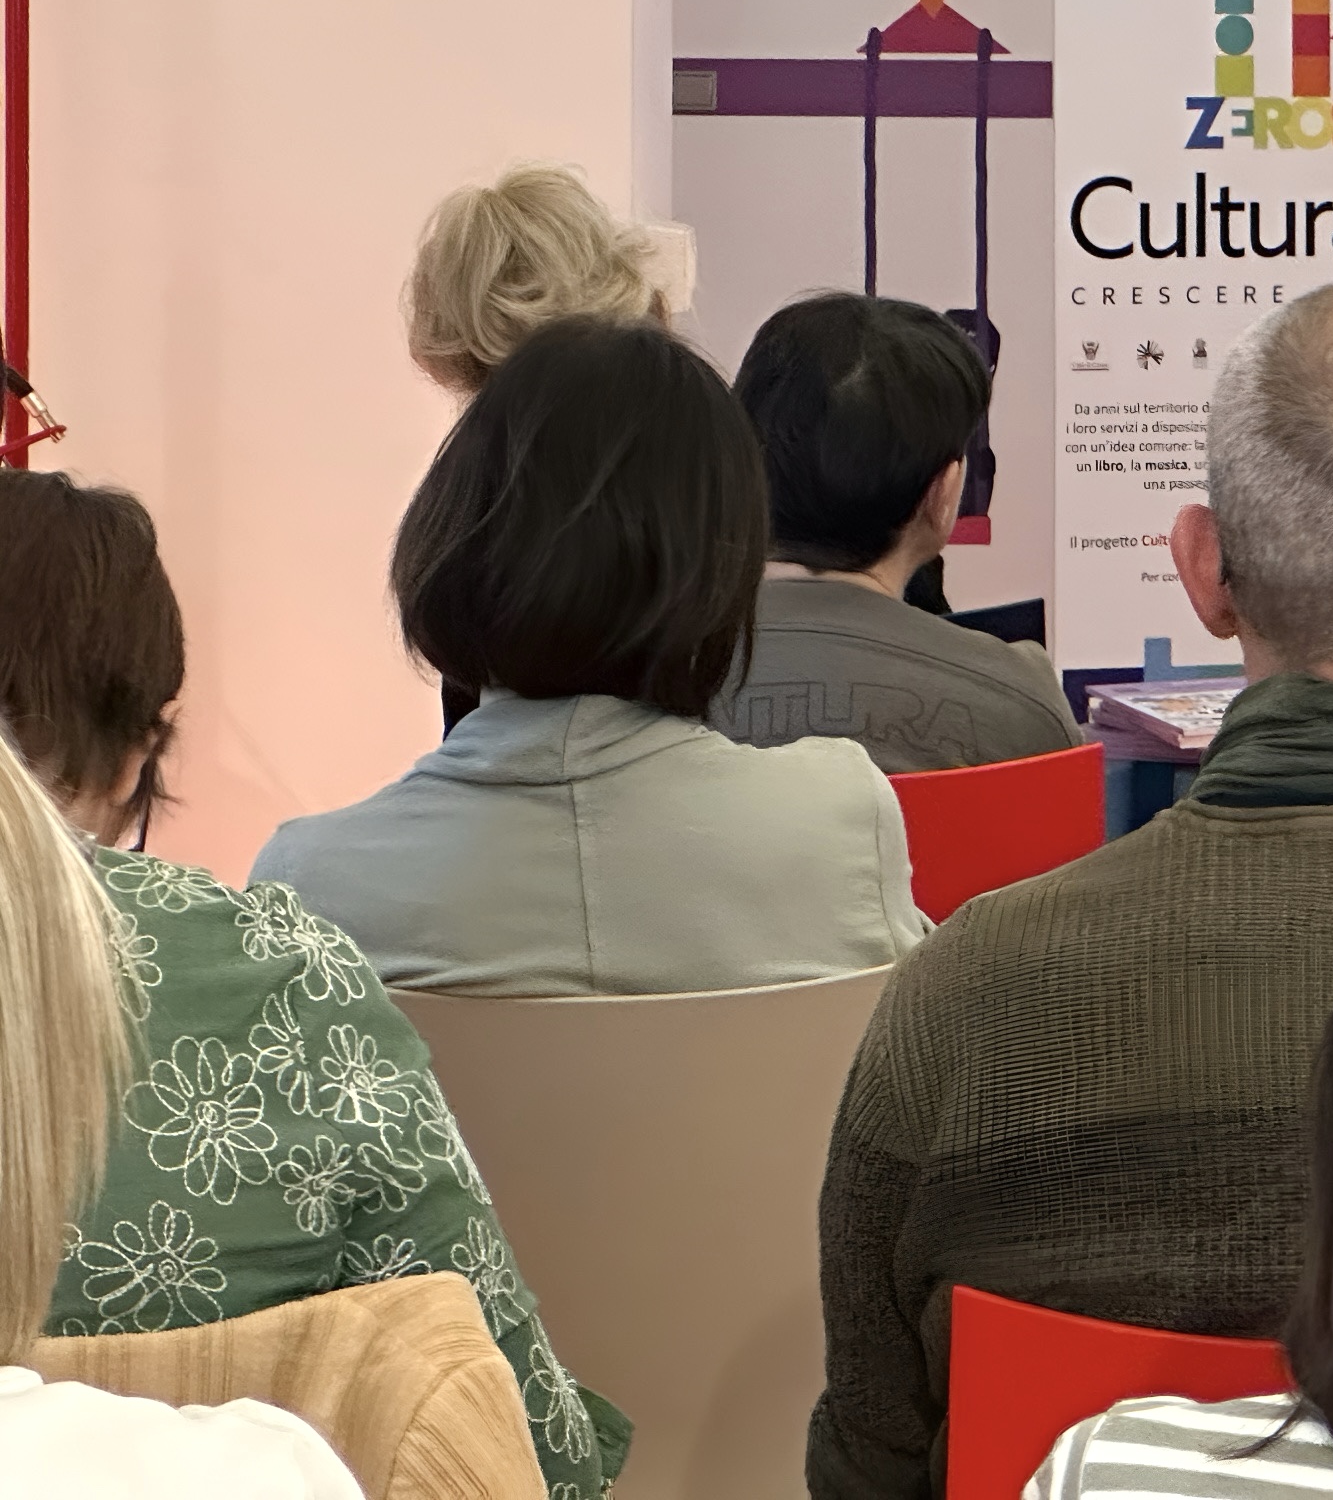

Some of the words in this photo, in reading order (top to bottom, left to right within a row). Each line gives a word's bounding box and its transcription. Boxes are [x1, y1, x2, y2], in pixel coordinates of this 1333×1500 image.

[1071, 285, 1285, 306] CRESCERE
[1074, 403, 1091, 415] Da
[1093, 403, 1121, 415] anni
[1123, 402, 1141, 414] sul
[1144, 402, 1199, 414] territorio
[1073, 422, 1097, 434] loro
[1100, 422, 1138, 434] servizi
[1152, 421, 1208, 436] disposizi
[1065, 443, 1087, 453] con
[1076, 462, 1092, 472] un
[1095, 459, 1127, 473] libro,
[1131, 459, 1141, 471] la
[1070, 536, 1078, 548] Il
[1081, 536, 1138, 551] progetto
[1141, 534, 1170, 547] Cult
